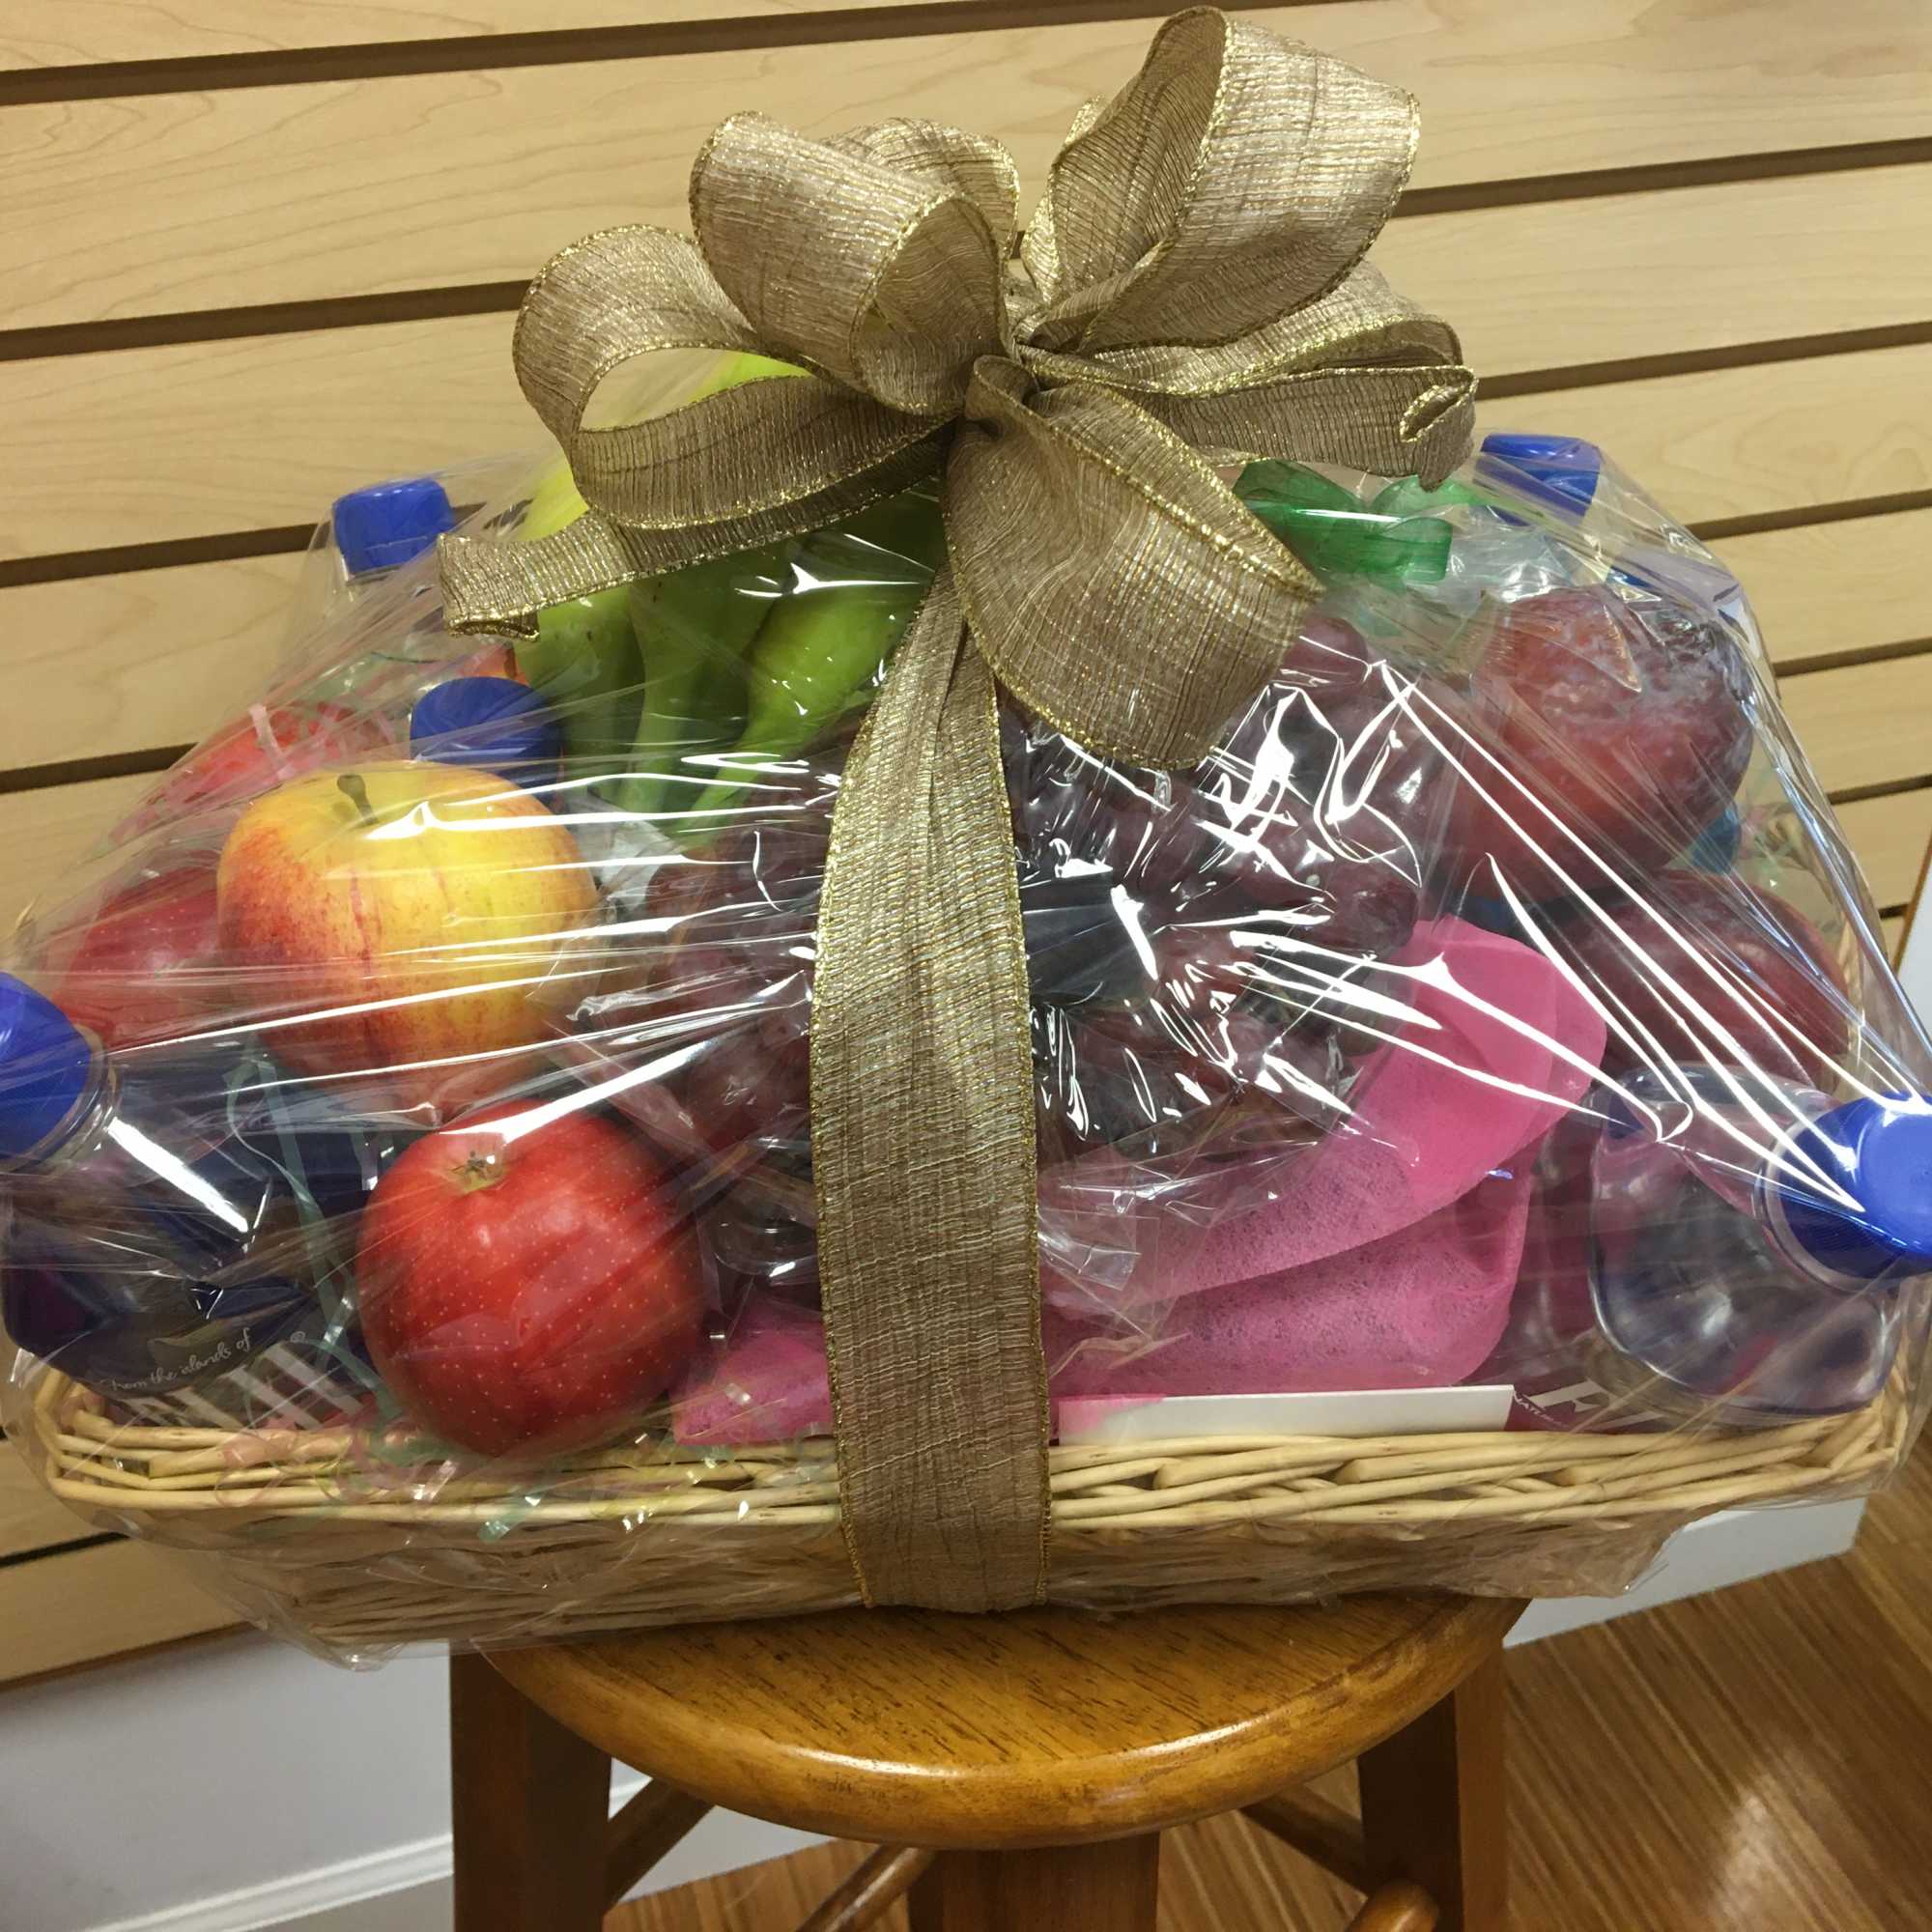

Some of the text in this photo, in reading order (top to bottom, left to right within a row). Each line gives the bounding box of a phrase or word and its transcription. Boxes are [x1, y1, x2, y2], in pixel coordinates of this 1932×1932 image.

[150, 1367, 179, 1385] the
[181, 1341, 233, 1377] islands
[236, 1326, 252, 1352] of
